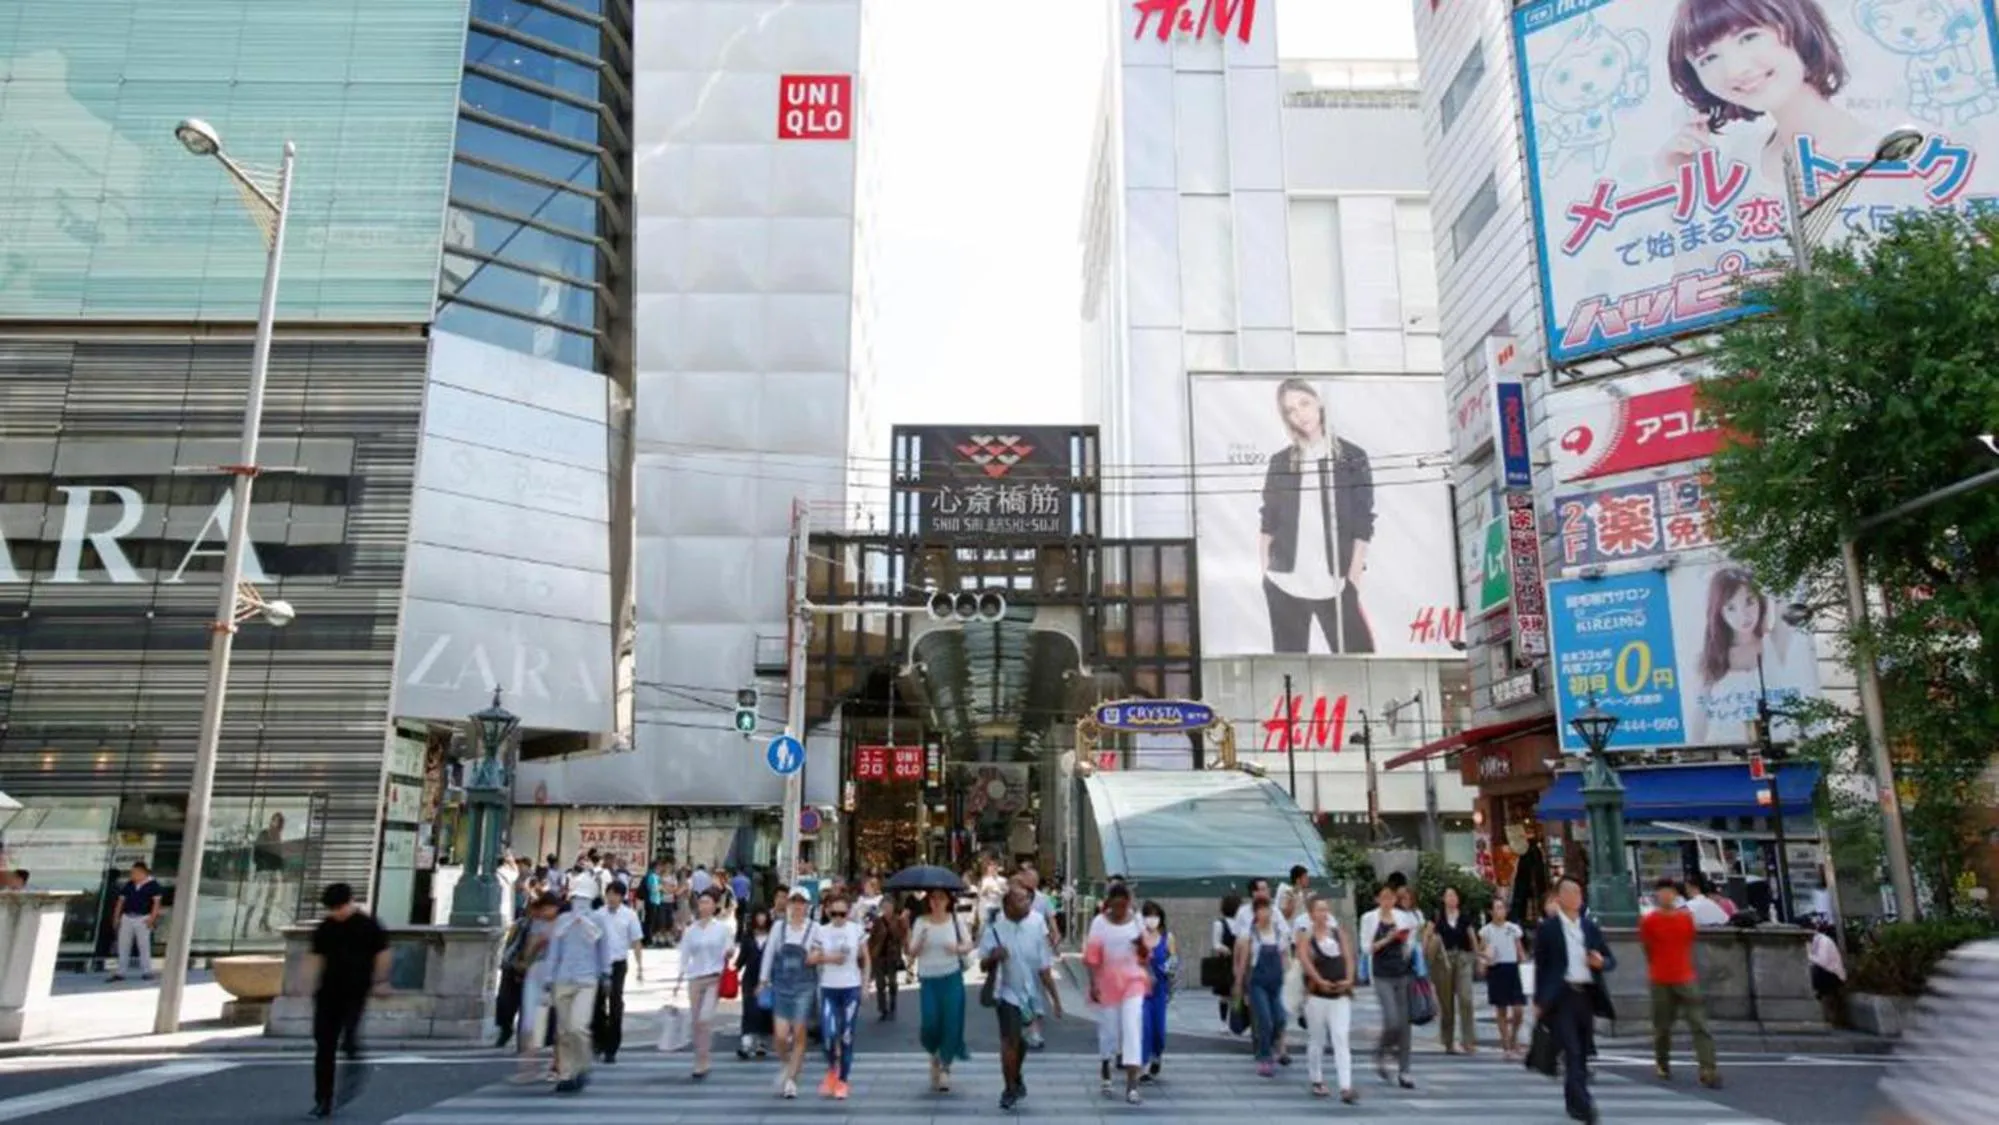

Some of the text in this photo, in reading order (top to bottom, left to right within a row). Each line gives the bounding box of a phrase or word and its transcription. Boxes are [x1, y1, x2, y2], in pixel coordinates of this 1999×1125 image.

[1133, 0, 1257, 44] H&M
[787, 83, 839, 106] UNI
[786, 109, 843, 136] QLO
[1793, 132, 1978, 205] トーク
[1563, 149, 1748, 256] メール
[931, 485, 1061, 516] 心斎橋筋
[1596, 494, 1657, 554] 薬
[1409, 607, 1464, 643] H&M
[406, 633, 599, 704] ZARA
[1616, 642, 1651, 695] 0
[1262, 695, 1348, 753] H&M
